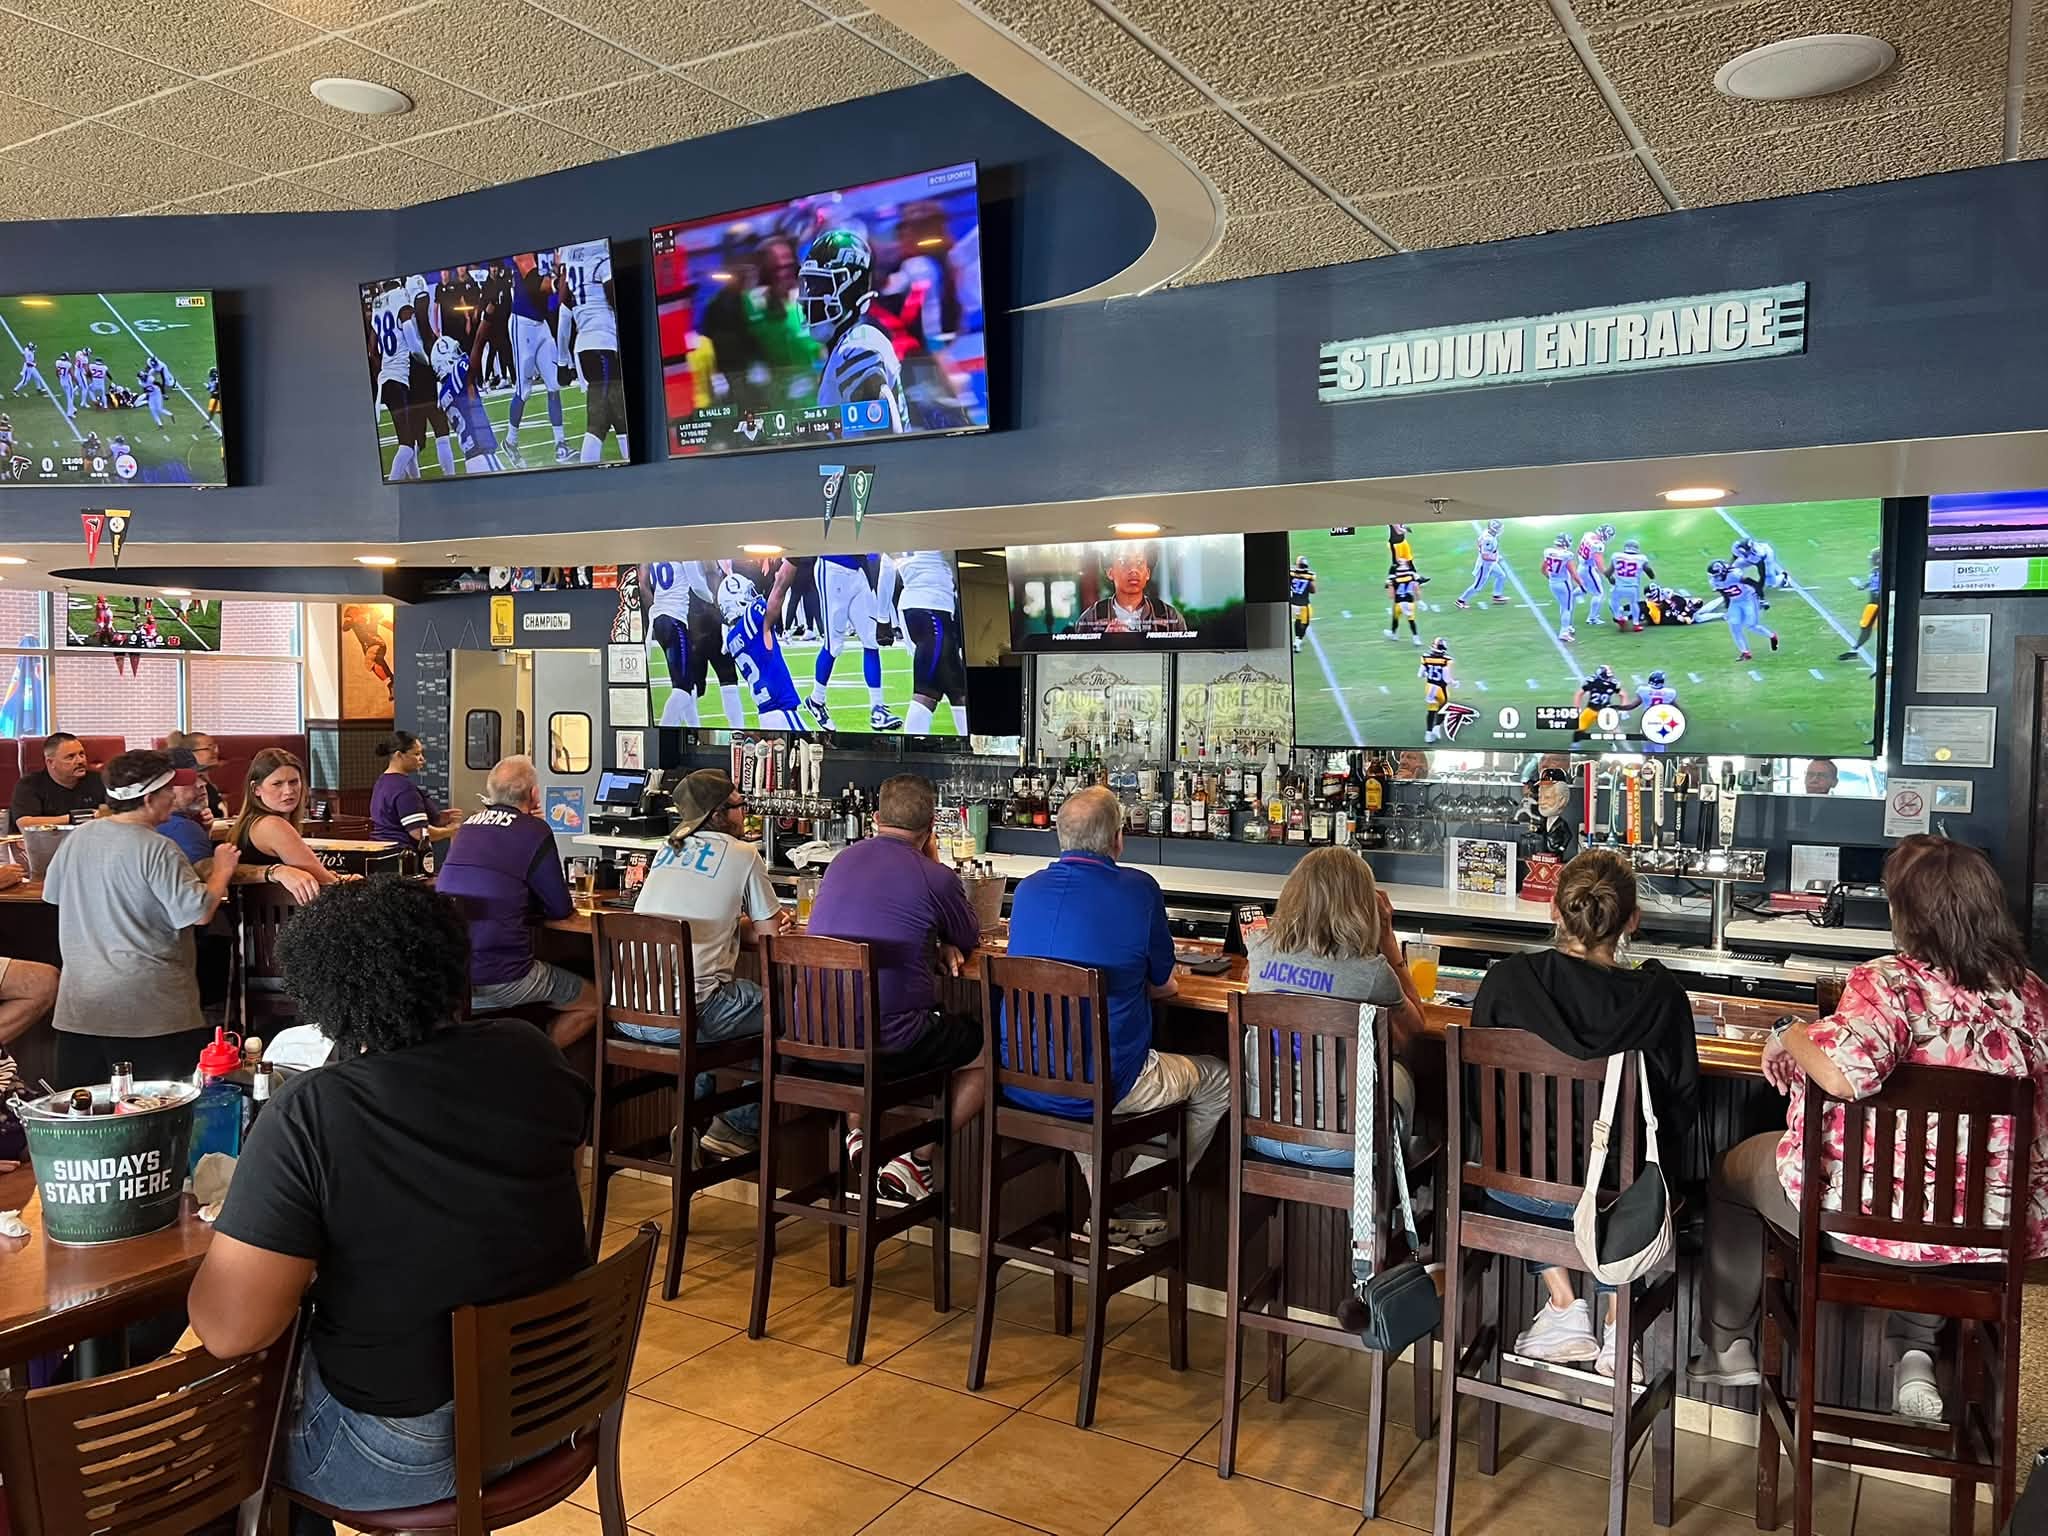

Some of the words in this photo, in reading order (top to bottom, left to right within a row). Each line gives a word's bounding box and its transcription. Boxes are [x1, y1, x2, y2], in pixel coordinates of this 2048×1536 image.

[1340, 328, 1525, 392] STADIUM
[1535, 298, 1776, 371] ENTRANCE
[776, 413, 785, 430] 0
[848, 405, 858, 423] 0
[1616, 559, 1637, 578] 22
[1957, 565, 2000, 574] DISPLAY
[525, 615, 563, 628] CHAMPION
[619, 657, 638, 671] 130
[1499, 708, 1519, 729] 0
[1537, 708, 1579, 719] 12:05
[1598, 707, 1619, 730] 0
[1259, 961, 1335, 994] JACKSON
[53, 1150, 161, 1182] SUNDAYS
[45, 1181, 111, 1205] START
[119, 1168, 172, 1201] HERE
